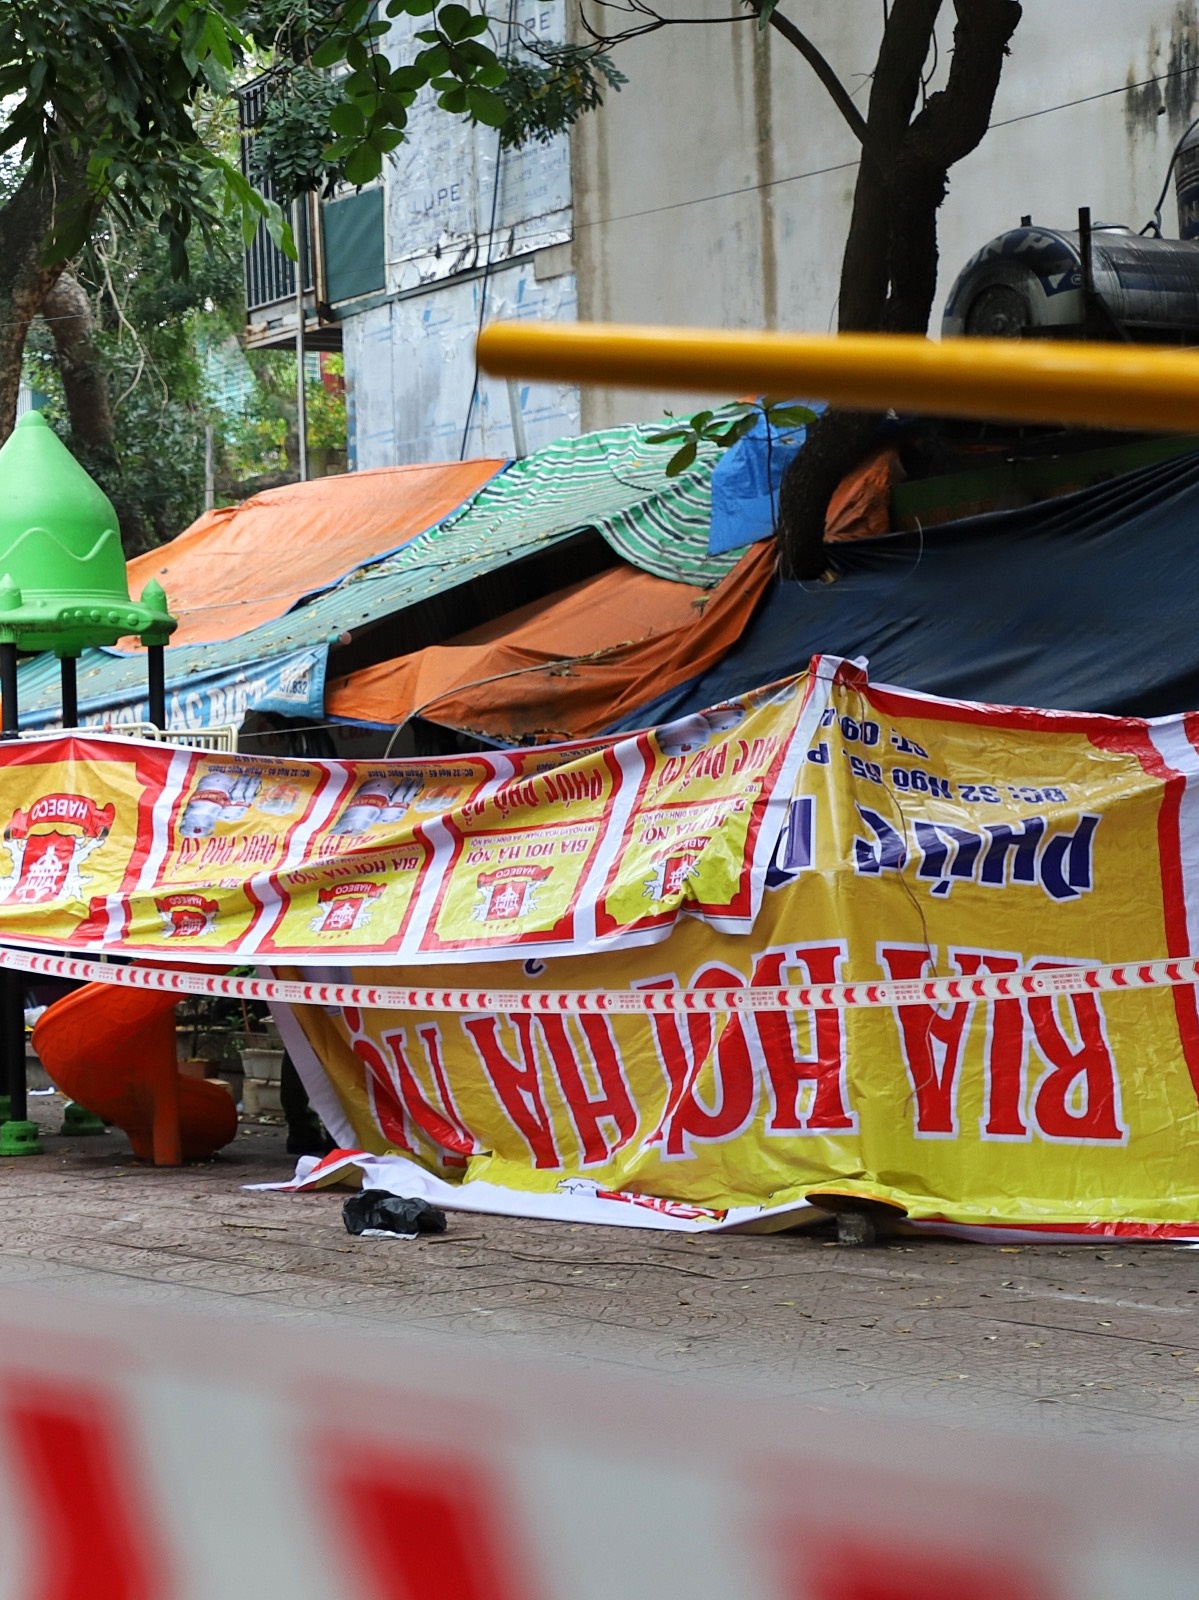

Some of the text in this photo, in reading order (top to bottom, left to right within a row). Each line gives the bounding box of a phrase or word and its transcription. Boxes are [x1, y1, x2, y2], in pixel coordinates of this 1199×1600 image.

[542, 769, 603, 809] PHÚC
[892, 767, 953, 800] Ngõ
[958, 784, 1002, 803] 32
[1011, 785, 1069, 803] ĐC:
[31, 798, 89, 820] HABECO
[639, 823, 670, 845] NỘI
[466, 839, 588, 865] BIA HƠI HÀ NỘI
[854, 801, 1103, 900] PHÚC
[356, 860, 387, 875] HƠI
[392, 856, 419, 871] BIA
[495, 867, 536, 878] HABECO
[335, 884, 372, 895] HABECO
[633, 938, 860, 1162] HƠI
[877, 941, 1128, 1146] BIA
